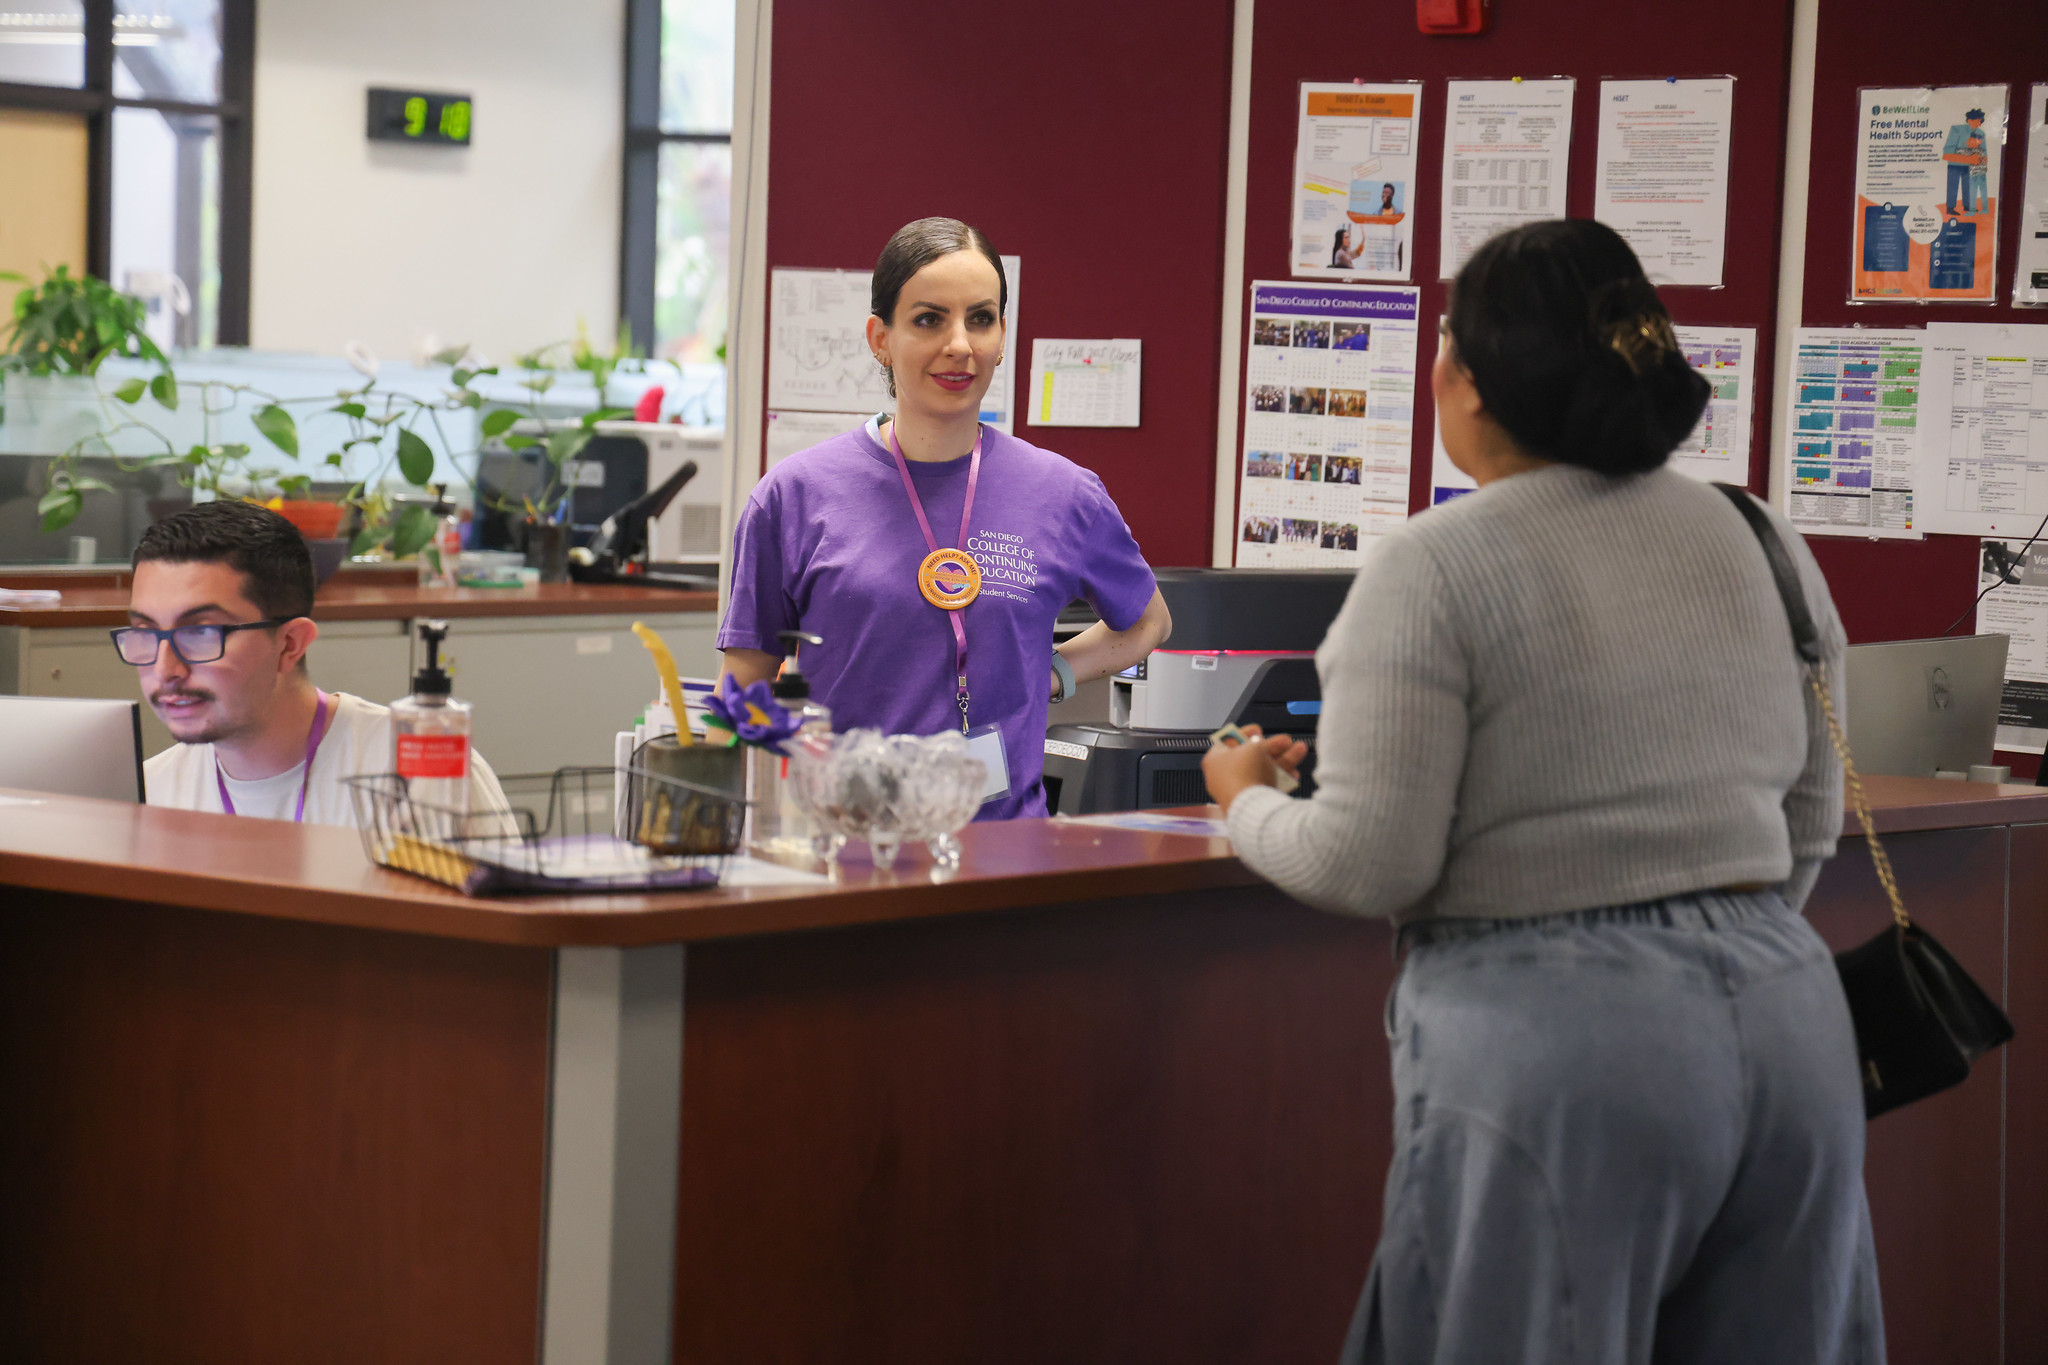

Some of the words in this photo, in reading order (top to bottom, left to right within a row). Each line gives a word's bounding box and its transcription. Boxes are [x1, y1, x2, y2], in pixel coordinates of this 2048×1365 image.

[1870, 120, 1893, 129] Free
[1895, 119, 1929, 129] Mental
[1870, 131, 1902, 140] Health
[1904, 130, 1943, 141] Support
[1256, 294, 1270, 304] SAN
[1270, 295, 1292, 306] DIEGO
[1292, 296, 1320, 307] COLLEGE
[1320, 297, 1332, 307] OF
[1332, 298, 1376, 310] CONTINUING
[1376, 300, 1416, 311] EDUCATION
[980, 529, 997, 539] SAN
[998, 532, 1024, 544] DIEGO
[967, 537, 1020, 557] COLLEGE
[1021, 547, 1035, 560] OF
[926, 555, 941, 570] NEED
[959, 555, 971, 566] ASK
[978, 587, 1005, 598] Student
[1006, 590, 1029, 604] Services
